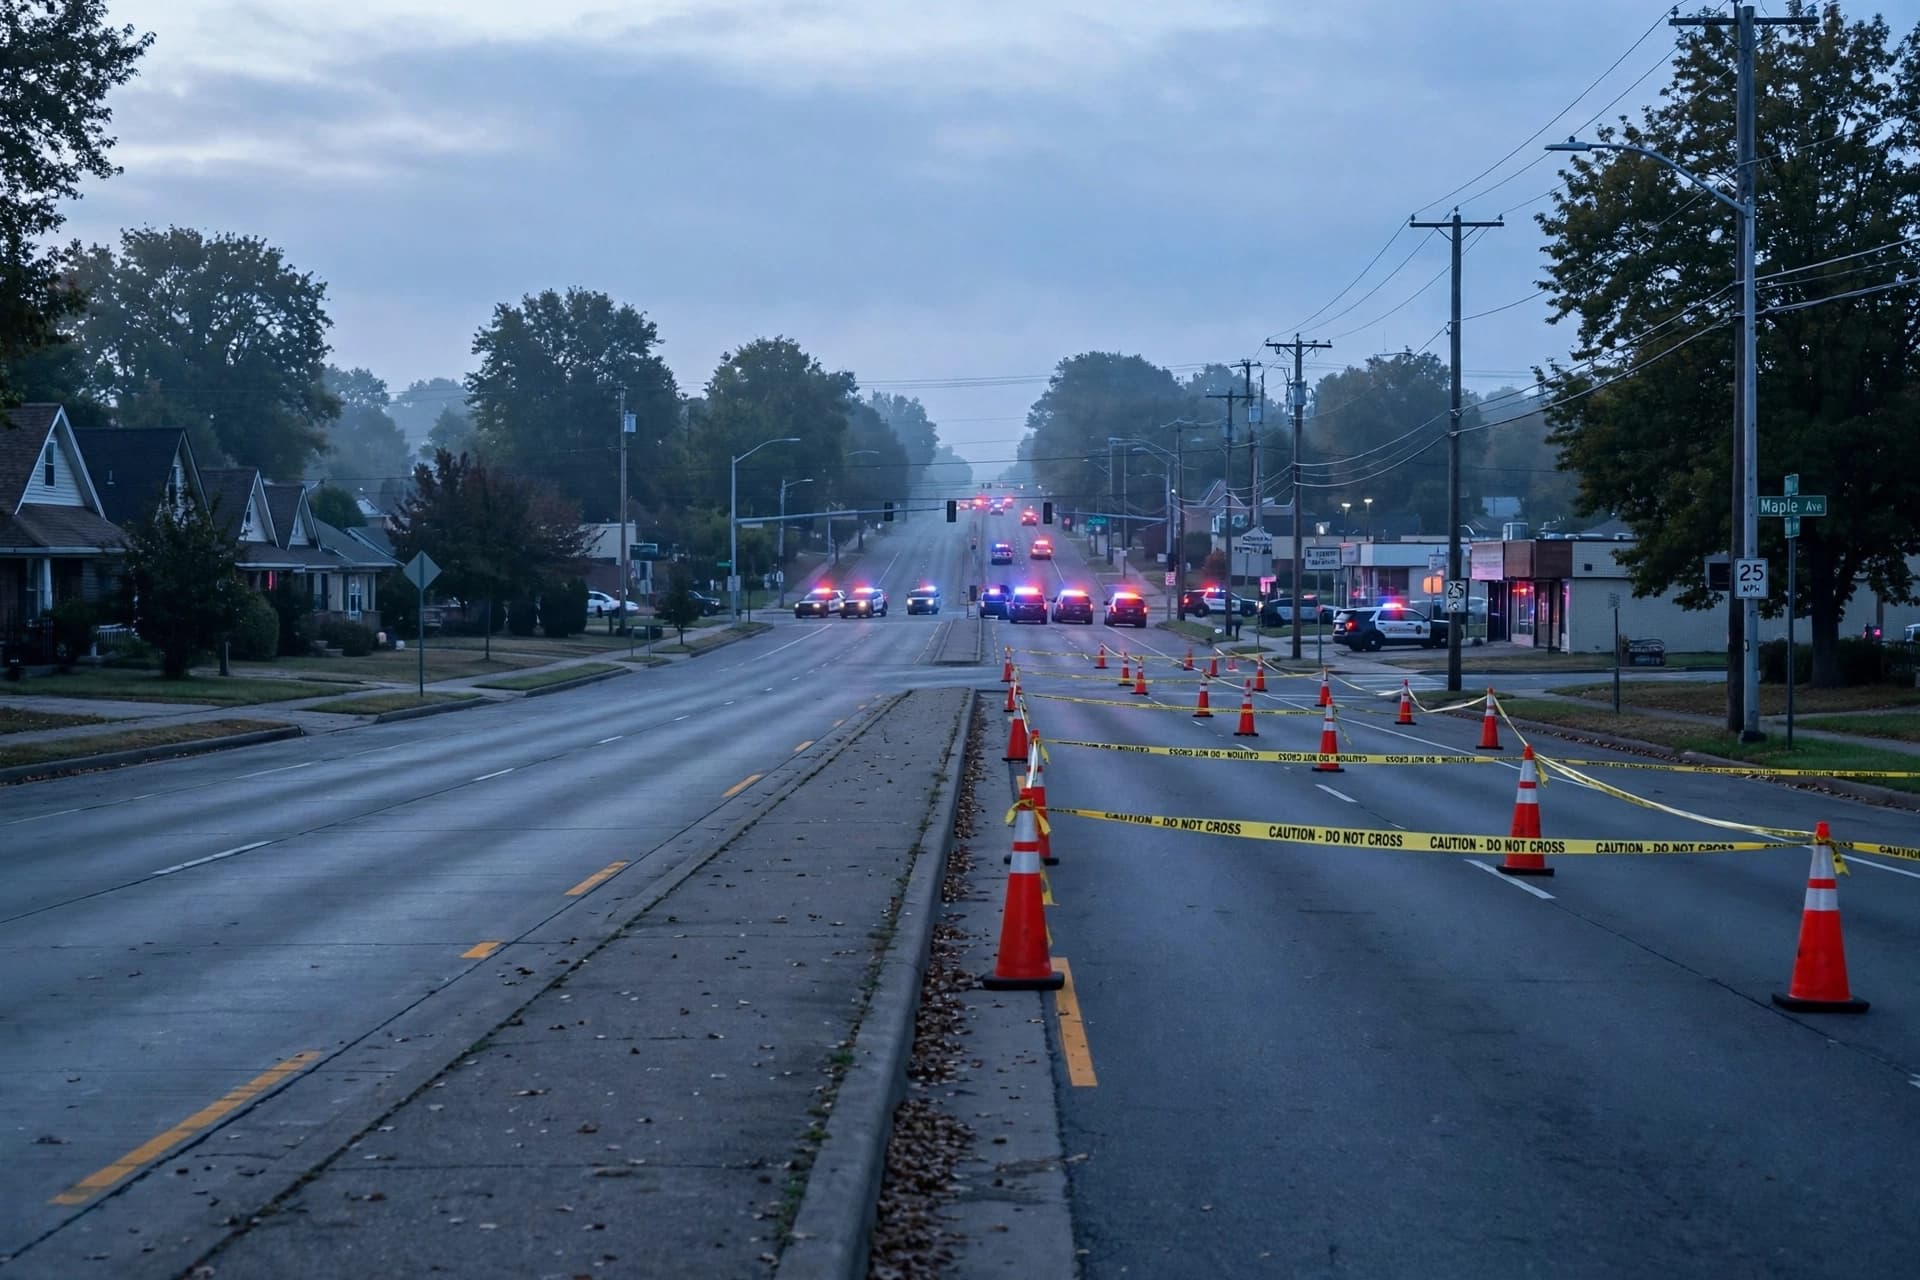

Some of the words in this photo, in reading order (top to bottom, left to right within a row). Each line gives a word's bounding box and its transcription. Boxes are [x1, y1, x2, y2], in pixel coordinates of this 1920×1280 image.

[1761, 499, 1798, 516] Maple
[1806, 501, 1823, 512] Ave
[1740, 564, 1764, 581] 25
[1195, 749, 1208, 758] NOT
[1210, 750, 1220, 758] DO
[1228, 750, 1259, 760] CAUTION
[1304, 753, 1318, 762] NOT
[1320, 754, 1330, 763] DO
[1336, 754, 1368, 763] CAUTION
[1105, 812, 1152, 824] CAUTION
[1162, 817, 1178, 828] DO
[1181, 819, 1203, 830] NOT
[1206, 821, 1241, 835] CROSS
[1269, 826, 1315, 841] CAUTION
[1325, 830, 1340, 843] DO
[1343, 832, 1365, 844] NOT
[1368, 833, 1403, 847] CROSS
[1430, 836, 1476, 850] CAUTION
[1486, 839, 1501, 851] DO
[1505, 840, 1527, 852] NOT
[1529, 841, 1565, 853] CROSS
[1596, 842, 1643, 853] CAUTION
[1653, 843, 1668, 853] DO
[1673, 843, 1694, 852] NOT
[1879, 845, 1920, 860] CAUTIO
